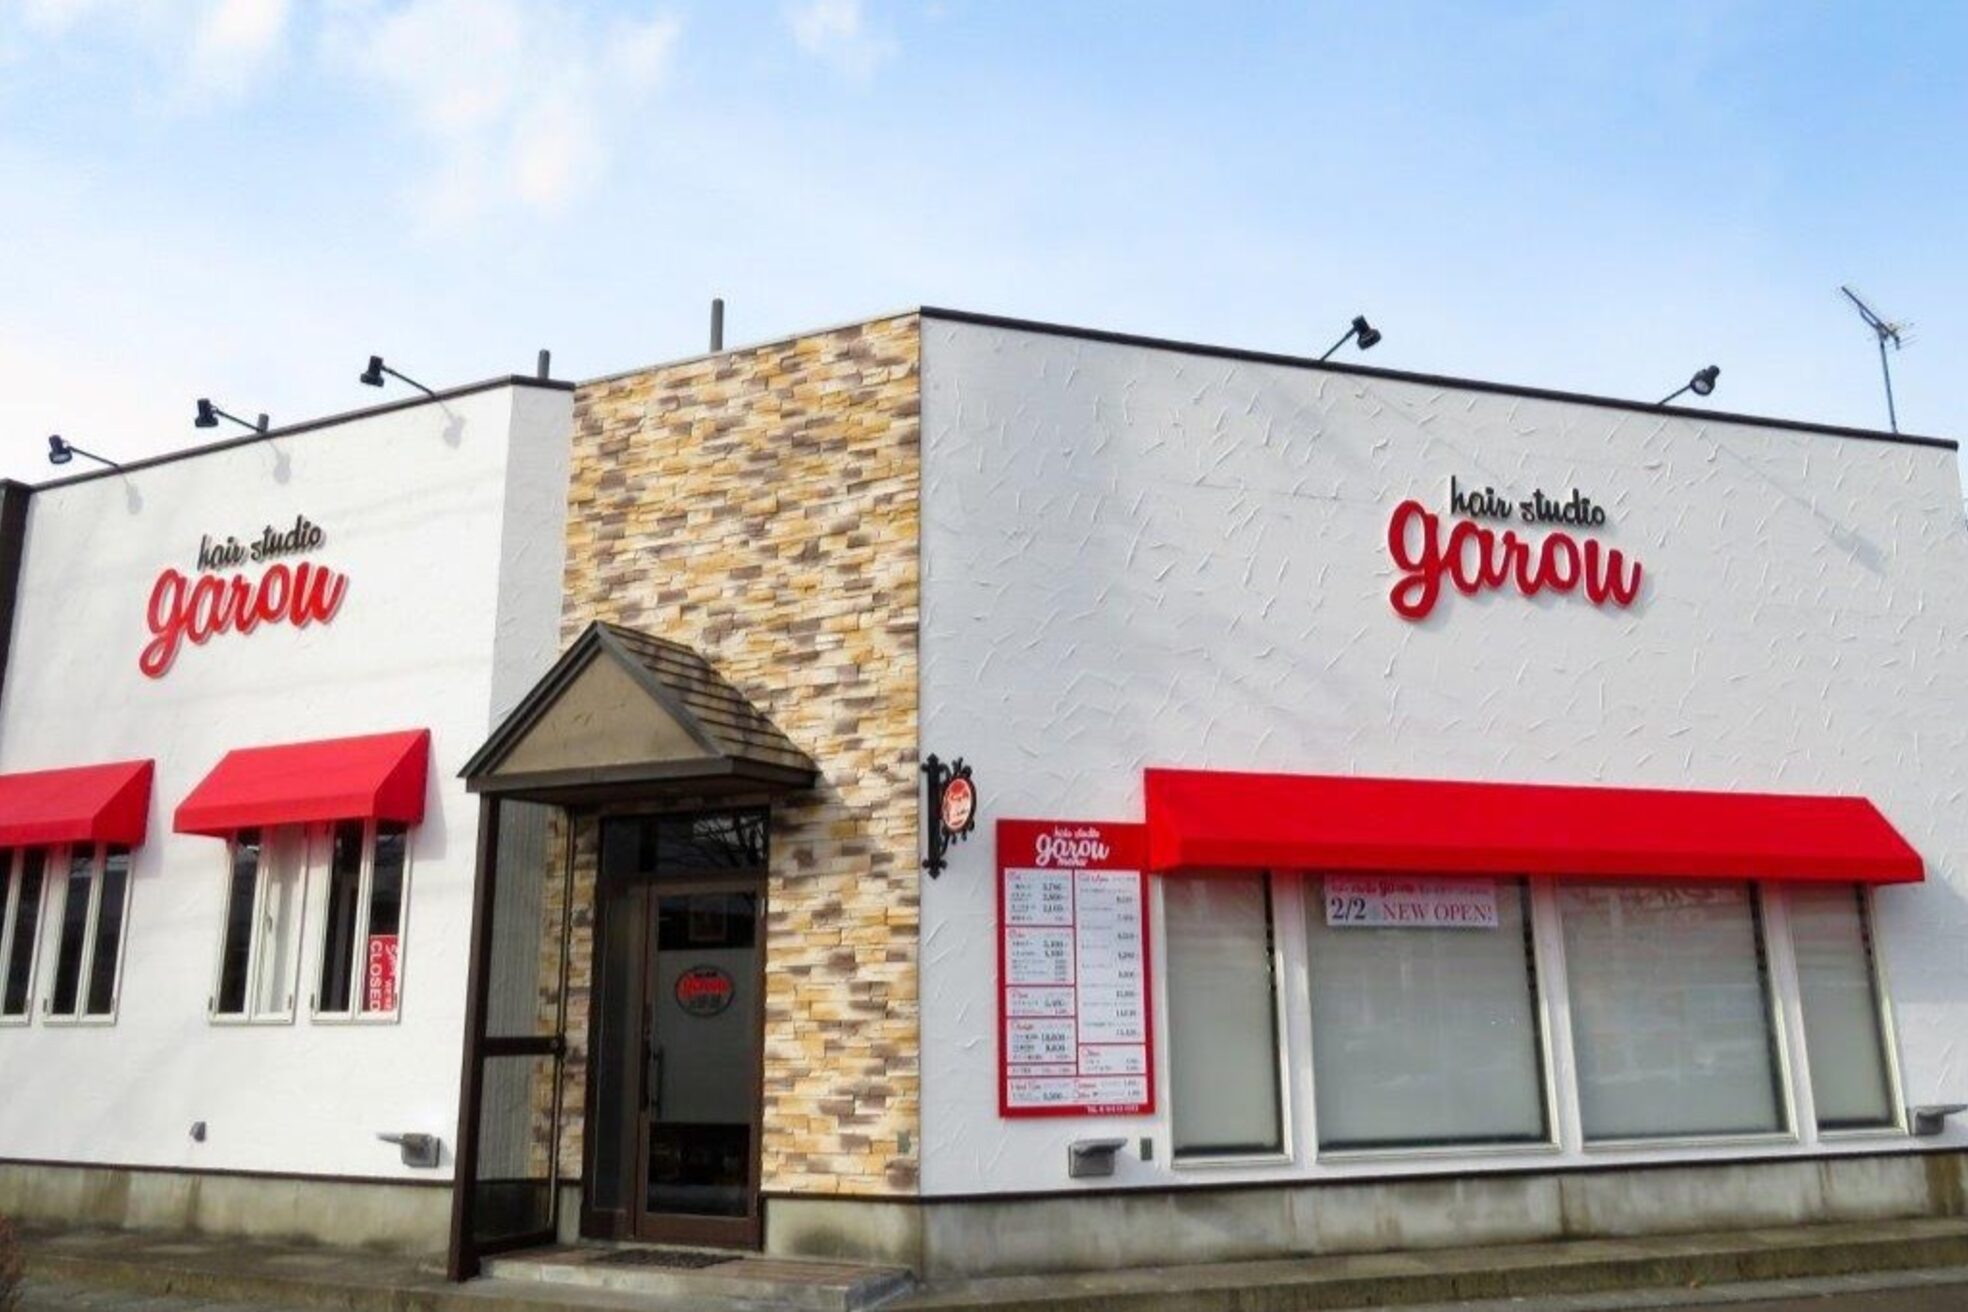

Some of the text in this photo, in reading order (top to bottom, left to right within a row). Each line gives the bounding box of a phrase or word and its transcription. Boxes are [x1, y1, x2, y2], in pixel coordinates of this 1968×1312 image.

[1450, 475, 1607, 525] hair studio
[197, 513, 324, 572] hair studio
[1331, 896, 1493, 922] 2/2 NEW OPEN!
[369, 940, 383, 1012] CLOSED
